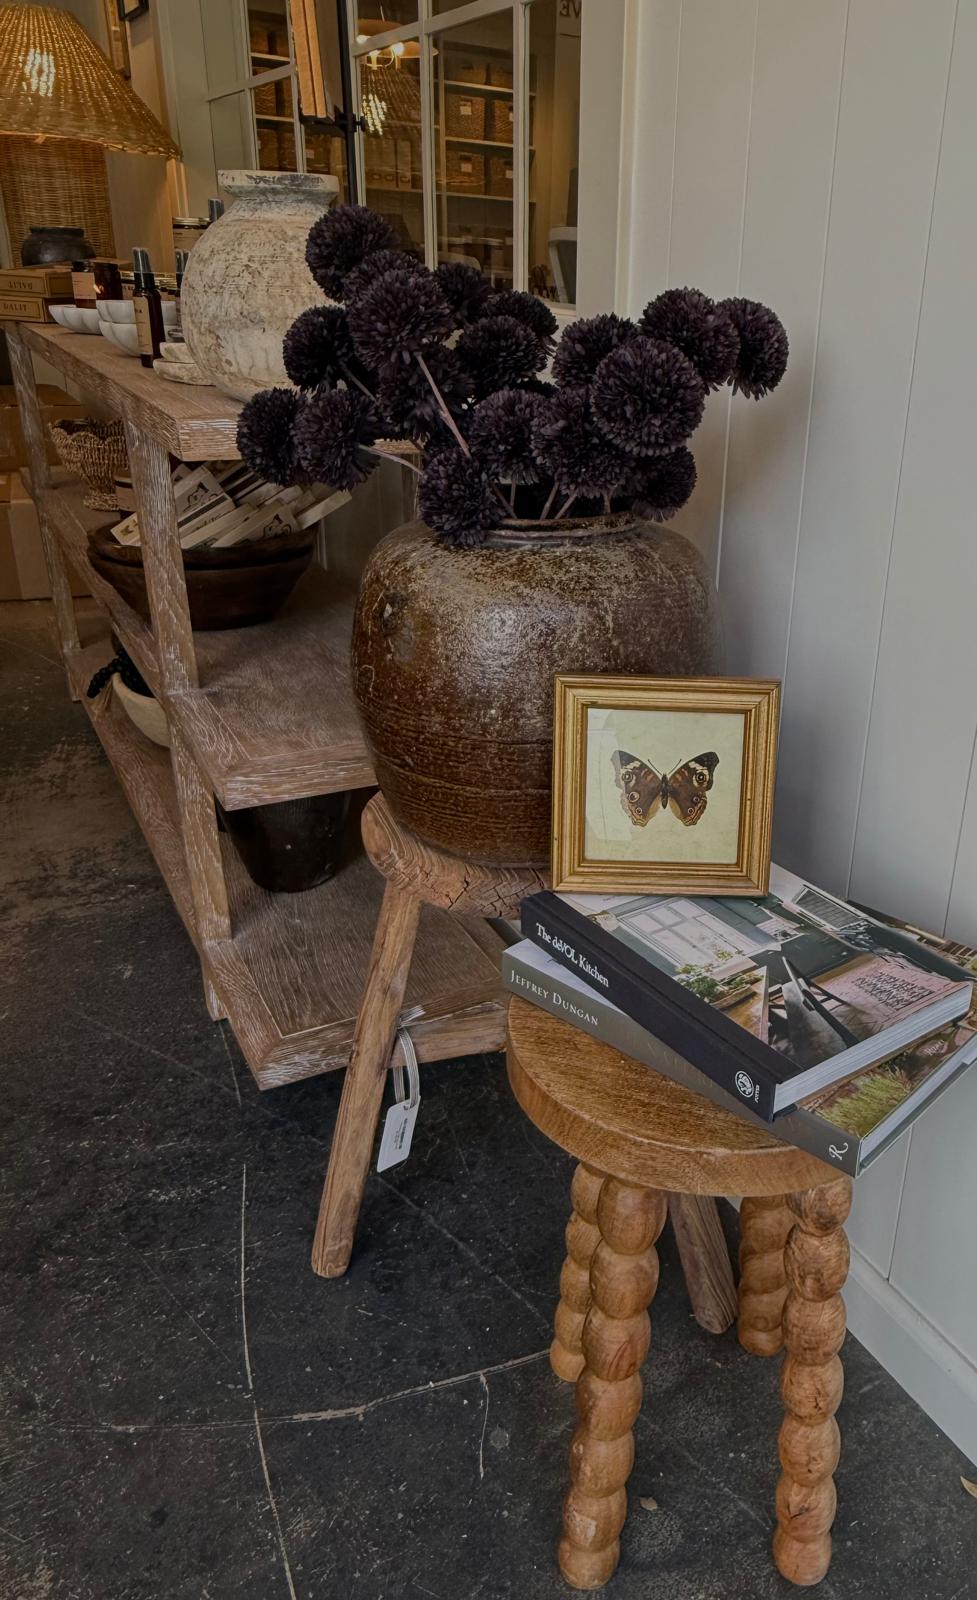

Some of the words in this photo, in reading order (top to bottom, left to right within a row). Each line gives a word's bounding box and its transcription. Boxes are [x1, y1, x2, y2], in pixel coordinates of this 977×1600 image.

[536, 922, 552, 944] The
[552, 935, 578, 964] deVOL
[578, 953, 609, 988] Kitchen
[510, 970, 549, 999] JEFFREY
[552, 992, 599, 1026] DUNGAN
